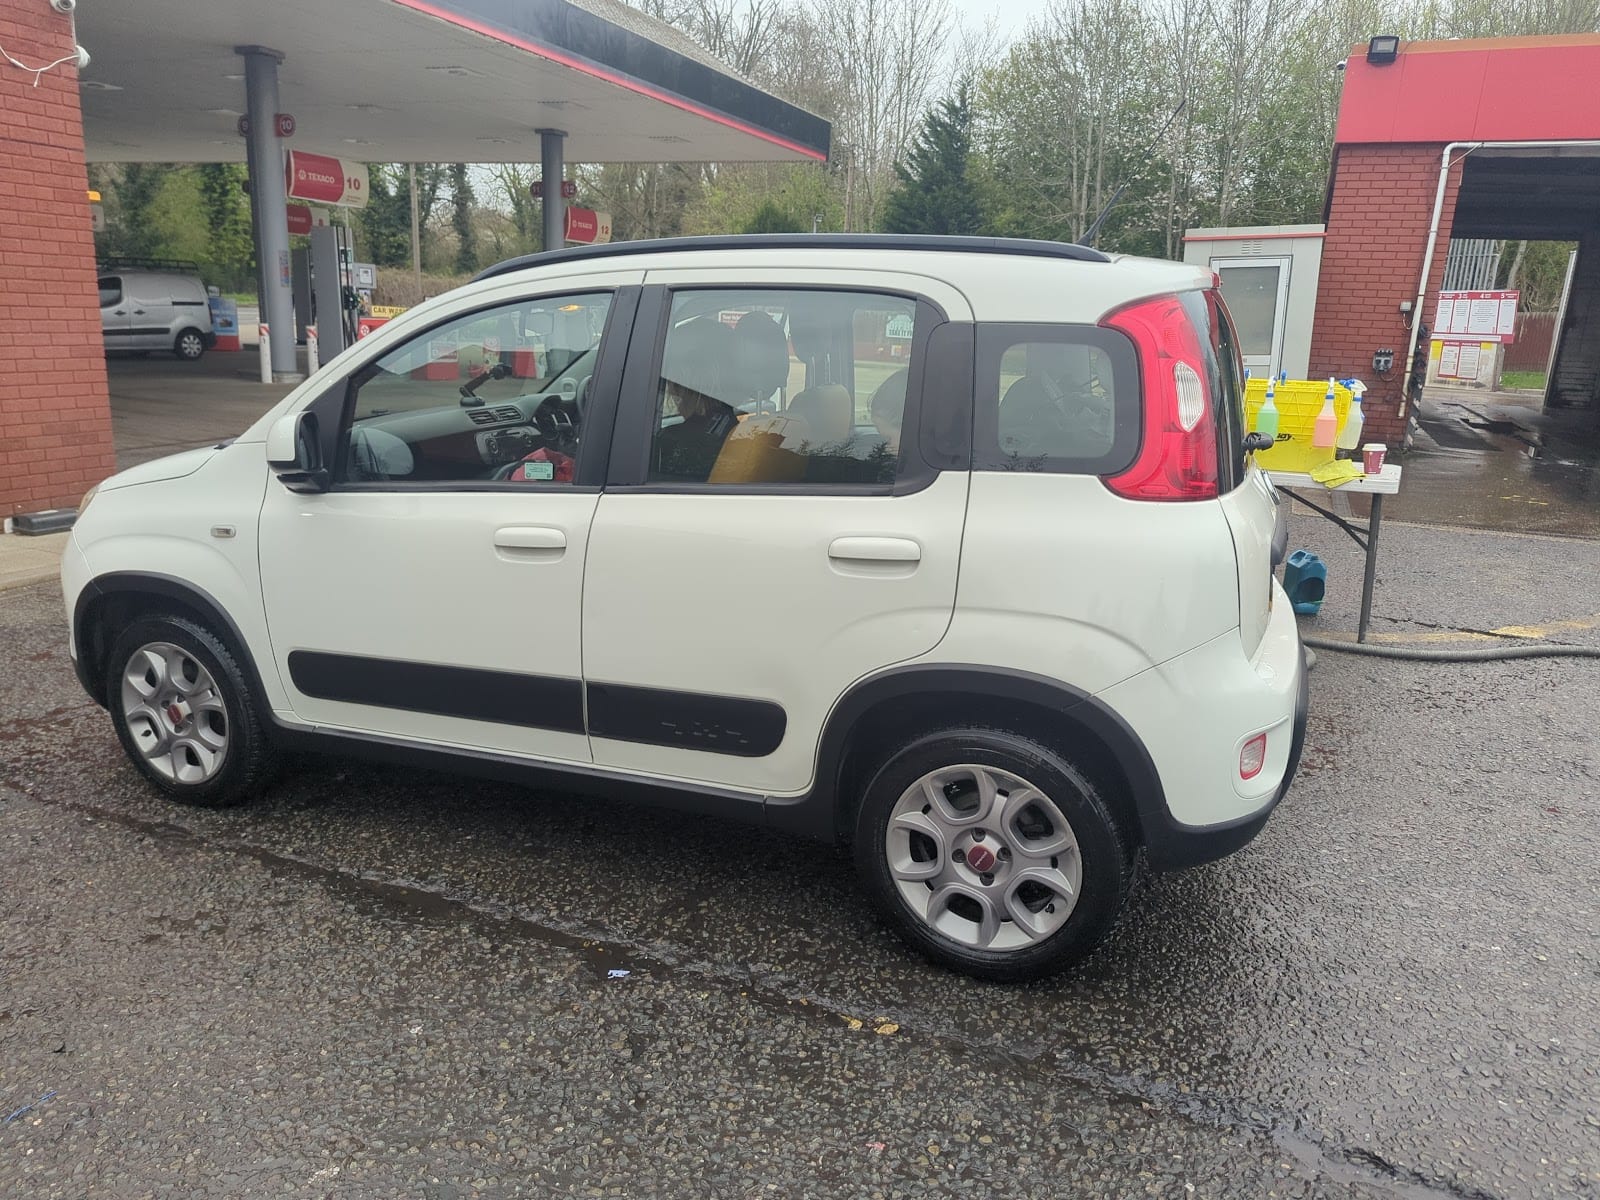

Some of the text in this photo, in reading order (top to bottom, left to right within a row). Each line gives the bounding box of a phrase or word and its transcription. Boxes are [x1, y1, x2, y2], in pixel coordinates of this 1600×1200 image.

[282, 119, 292, 130] 10
[307, 172, 335, 184] TEXACO
[347, 177, 361, 191] 10
[601, 225, 609, 235] 12
